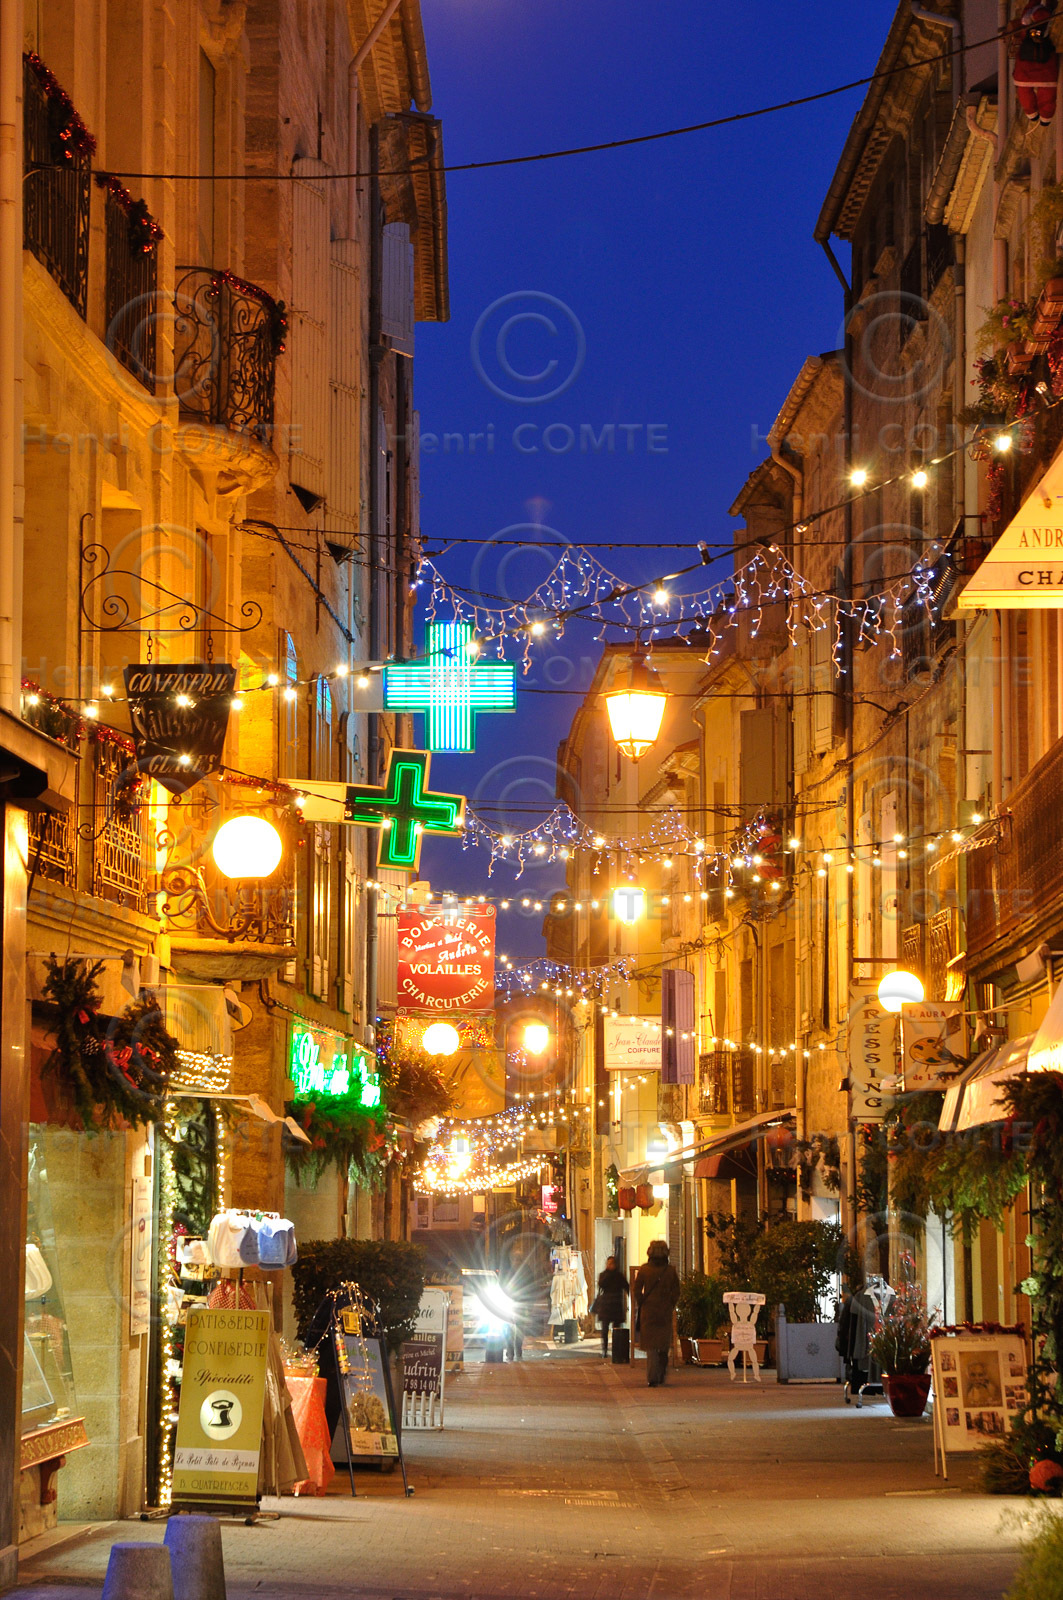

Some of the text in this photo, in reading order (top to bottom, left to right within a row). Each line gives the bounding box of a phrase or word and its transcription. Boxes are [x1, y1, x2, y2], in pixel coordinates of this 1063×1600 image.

[128, 672, 234, 694] CONFISERIE
[401, 916, 491, 948] BOUCHERIE
[409, 963, 482, 975] VOLAILLES
[402, 977, 489, 1009] CHARCUTERIE
[863, 994, 882, 1108] PRESSING
[189, 1314, 267, 1331] PATISSERIE
[187, 1340, 266, 1357] CONFISERIE
[194, 1368, 254, 1386] Spécialité
[403, 1360, 438, 1378] udrin
[420, 1380, 427, 1391] 14
[175, 1452, 184, 1464] Le
[186, 1453, 203, 1465] Petit
[221, 1457, 229, 1466] de
